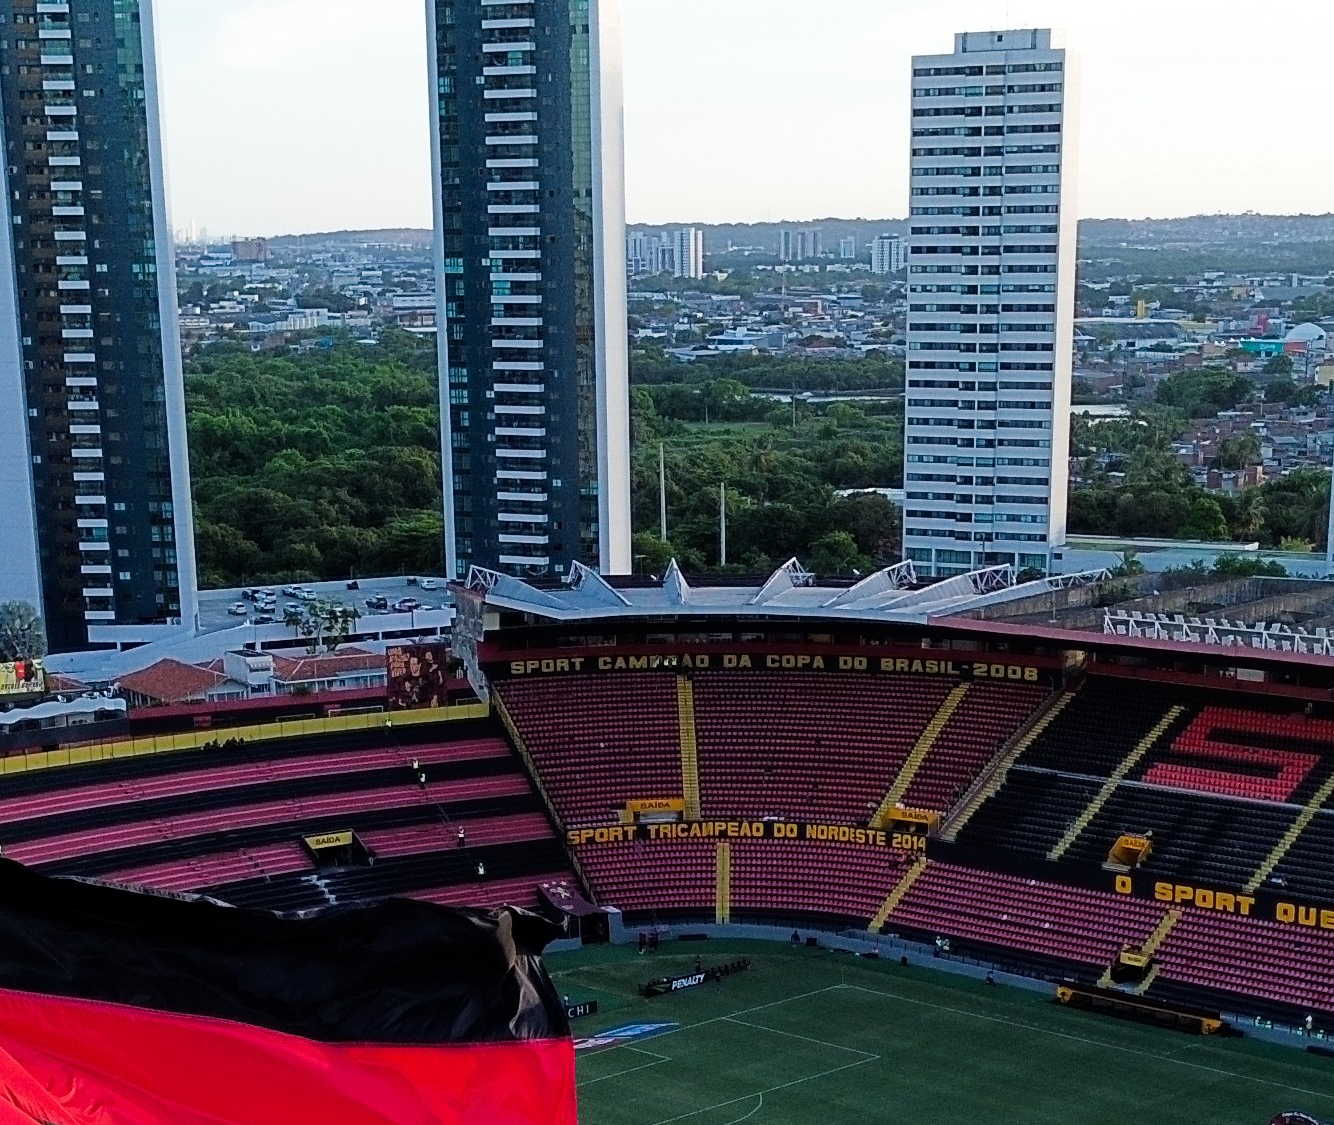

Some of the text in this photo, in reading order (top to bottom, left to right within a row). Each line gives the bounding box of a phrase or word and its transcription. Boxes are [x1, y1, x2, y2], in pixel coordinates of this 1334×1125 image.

[510, 657, 585, 675] SPORT
[723, 654, 752, 668] DA
[766, 655, 825, 669] COPA
[839, 656, 868, 670] DO
[567, 820, 927, 851] SPORT TRICAMPEÃO DO NORDESTE 2014
[1115, 875, 1132, 894] O
[1154, 881, 1255, 915] SPORT
[671, 972, 706, 990] PENALTY
